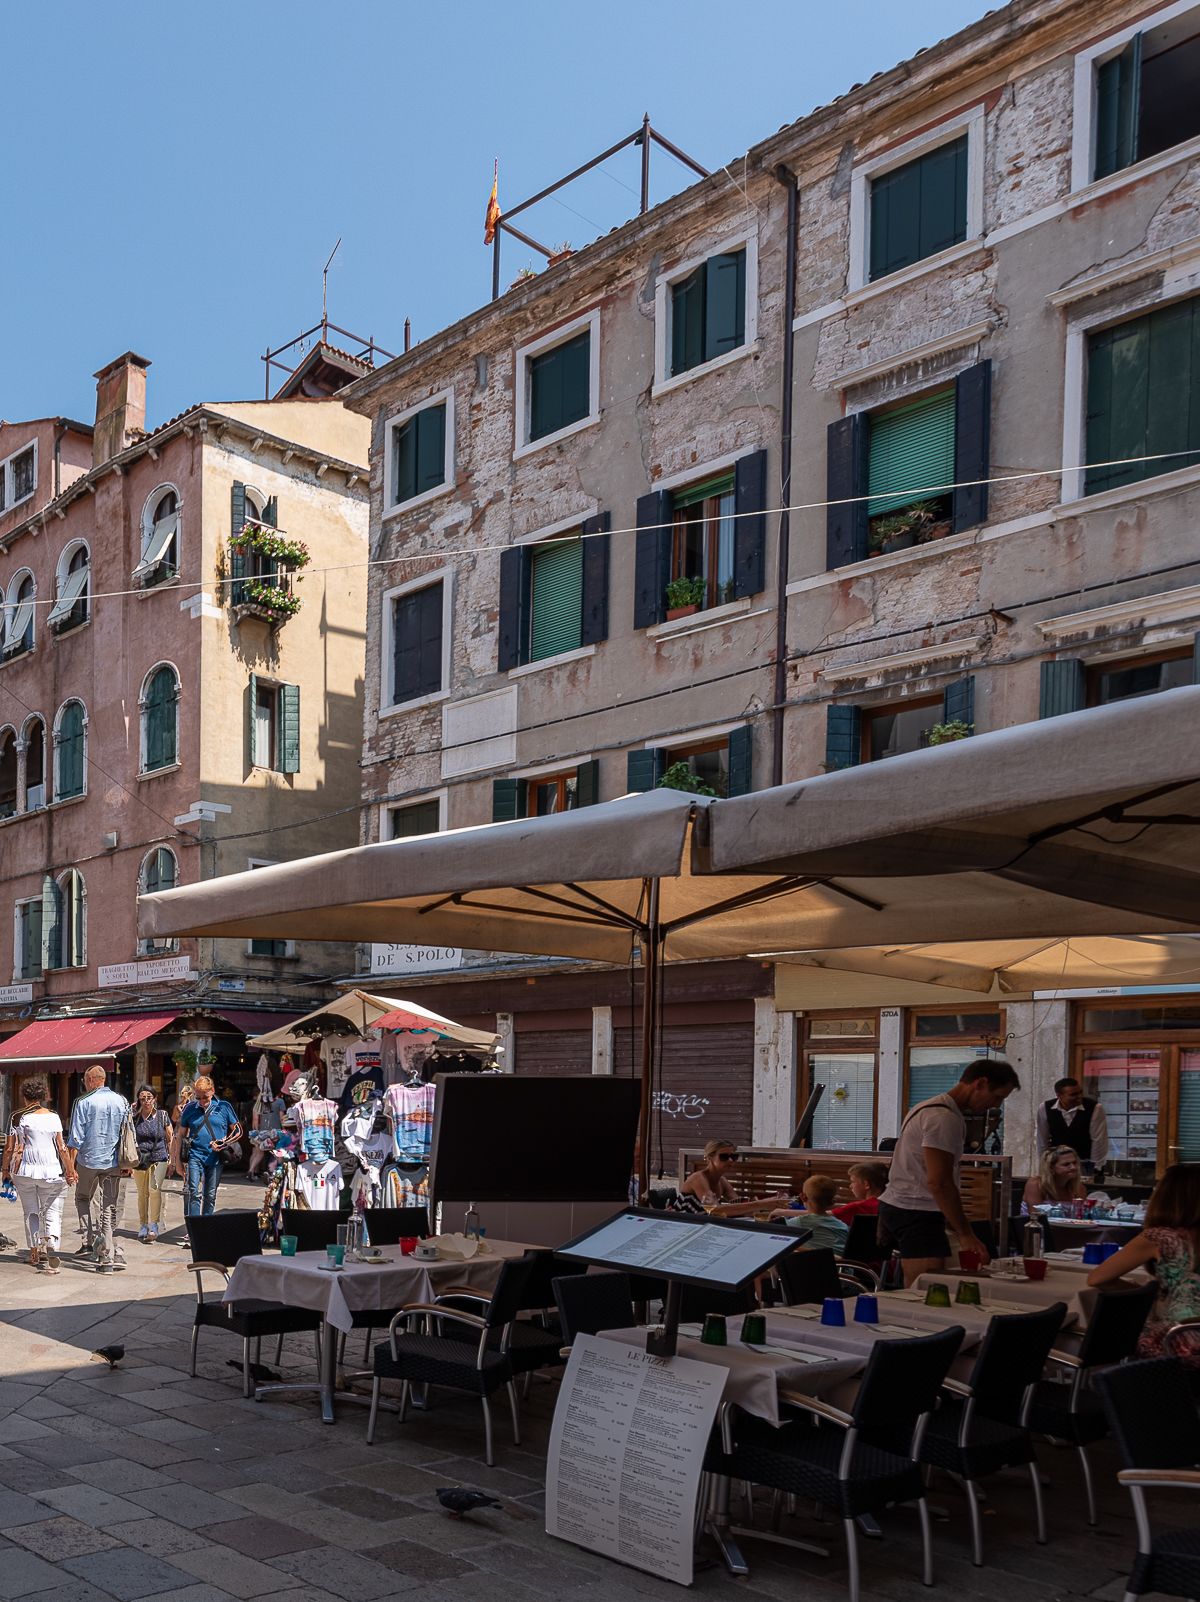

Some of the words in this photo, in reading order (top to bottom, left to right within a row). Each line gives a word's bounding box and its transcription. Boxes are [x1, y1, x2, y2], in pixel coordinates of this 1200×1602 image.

[145, 959, 180, 968] VAPORETTO
[377, 954, 395, 966] DE
[161, 966, 189, 974] MERCATO
[627, 1351, 641, 1360] LE
[641, 1353, 669, 1368] PIZZE
